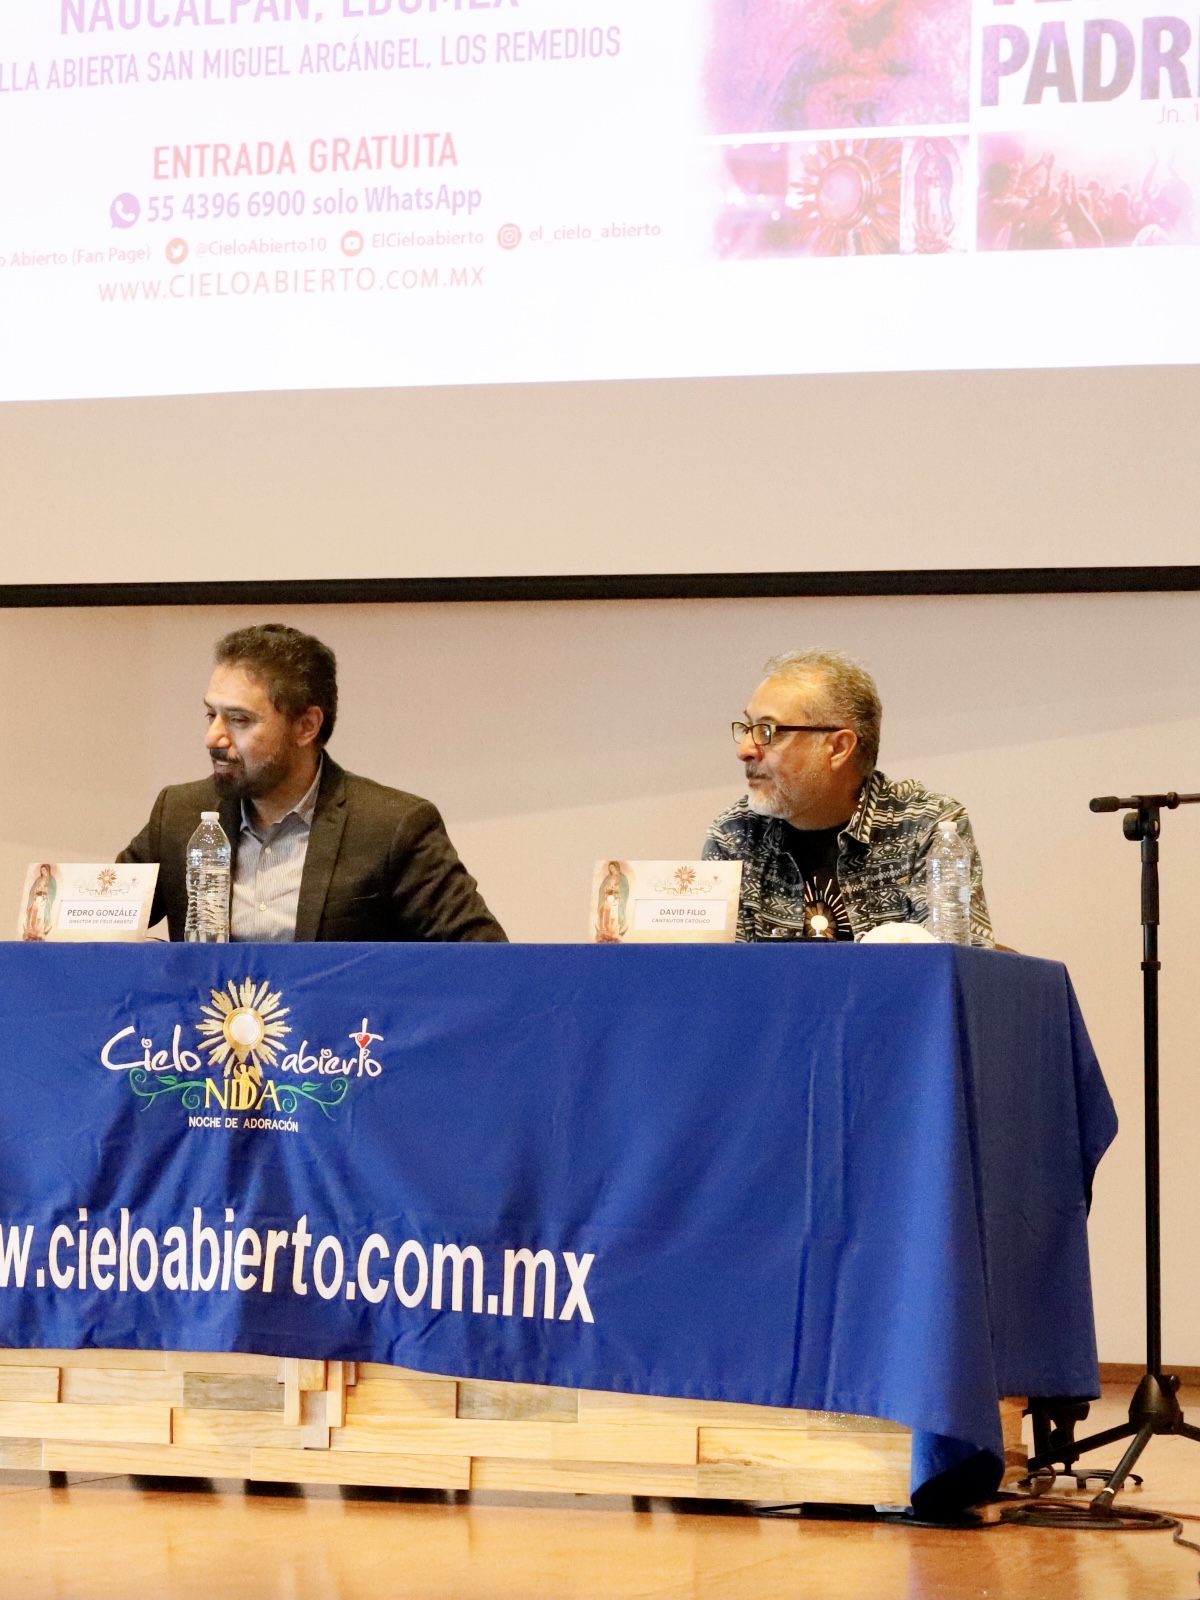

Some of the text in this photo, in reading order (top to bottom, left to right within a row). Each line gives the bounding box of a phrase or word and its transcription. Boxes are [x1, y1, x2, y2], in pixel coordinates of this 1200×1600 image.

[46, 54, 139, 89] ABIERTA
[147, 50, 193, 82] SAN
[202, 45, 291, 79] MIGUEL
[299, 34, 431, 75] ARCÁNGEL,
[441, 34, 486, 66] LOS
[496, 26, 620, 63] REMEDIOS
[981, 16, 1200, 107] PADR
[1157, 104, 1185, 124] Jn.
[154, 132, 457, 180] ENTRADA GRATUITA
[147, 184, 481, 222] 55 4396 6900 solo WhatsApp
[372, 230, 484, 249] ElCieloabierto
[529, 222, 661, 244] el_cielo_abierto
[10, 251, 67, 267] Abierto
[71, 248, 104, 265] (Fan
[108, 245, 151, 265] Page)
[195, 237, 327, 258] @CieloAbierto10
[98, 266, 485, 303] WWW.CIELOABIERTO.COM.MX
[67, 907, 138, 917] PEDRO GONZÁLEZ
[659, 908, 685, 916] DAVID
[100, 1017, 384, 1077] Cielo abierto
[204, 1077, 282, 1112] NDA
[188, 1116, 299, 1133] NOCHE DE ADORACIÓN
